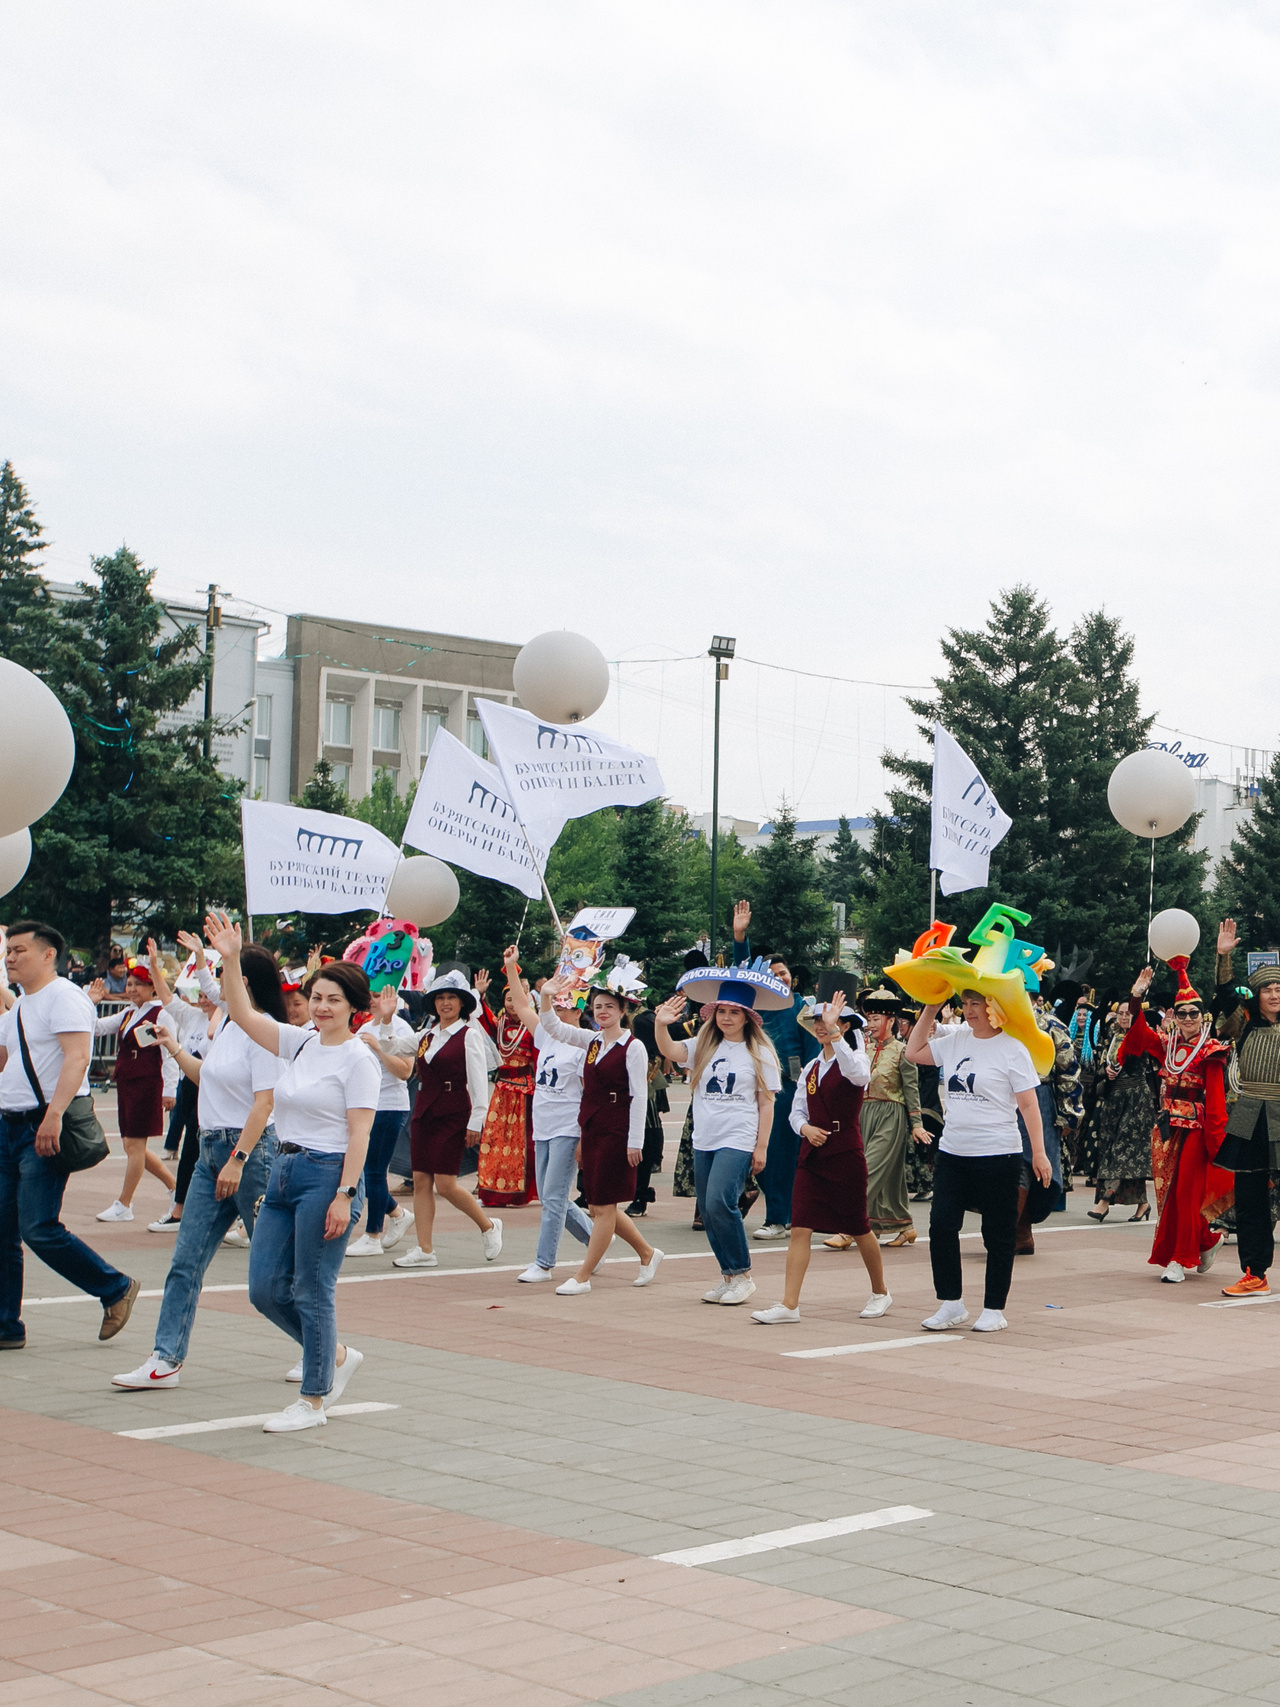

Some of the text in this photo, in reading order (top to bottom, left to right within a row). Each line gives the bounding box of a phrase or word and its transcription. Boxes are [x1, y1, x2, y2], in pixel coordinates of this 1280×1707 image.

[583, 773, 646, 789] БАЛЕТА
[432, 801, 511, 844] БУРЯТСКИЙ
[428, 815, 540, 876] ОПЕРЫ И БАЛЕТ
[269, 860, 341, 879] БУРЯТСКИЙ
[593, 909, 618, 919] СИЛА
[736, 970, 790, 997] БУДУЩЕГО
